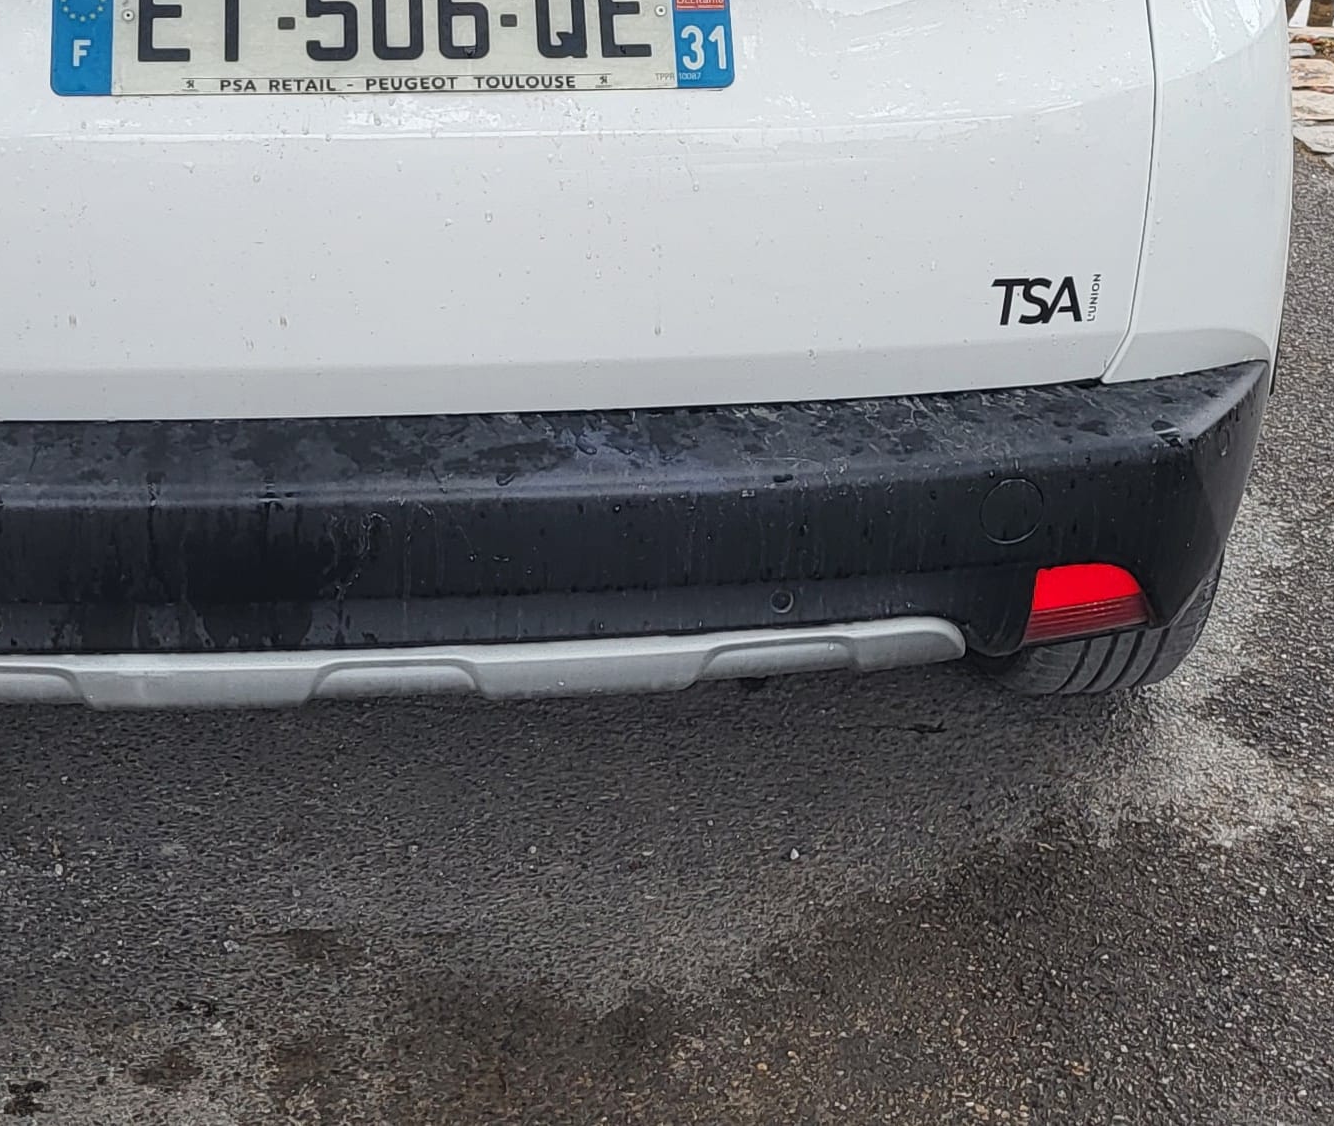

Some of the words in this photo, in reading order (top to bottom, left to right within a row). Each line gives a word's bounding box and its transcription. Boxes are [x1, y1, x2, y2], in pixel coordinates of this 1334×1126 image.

[72, 39, 92, 67] F
[680, 24, 727, 71] 31
[219, 79, 257, 92] PSA
[268, 79, 337, 92] RETAIL
[366, 76, 459, 91] PEUGEOT
[473, 75, 576, 89] TOULOUSE
[991, 275, 1083, 326] TSA
[1086, 273, 1102, 322] L'UNION
